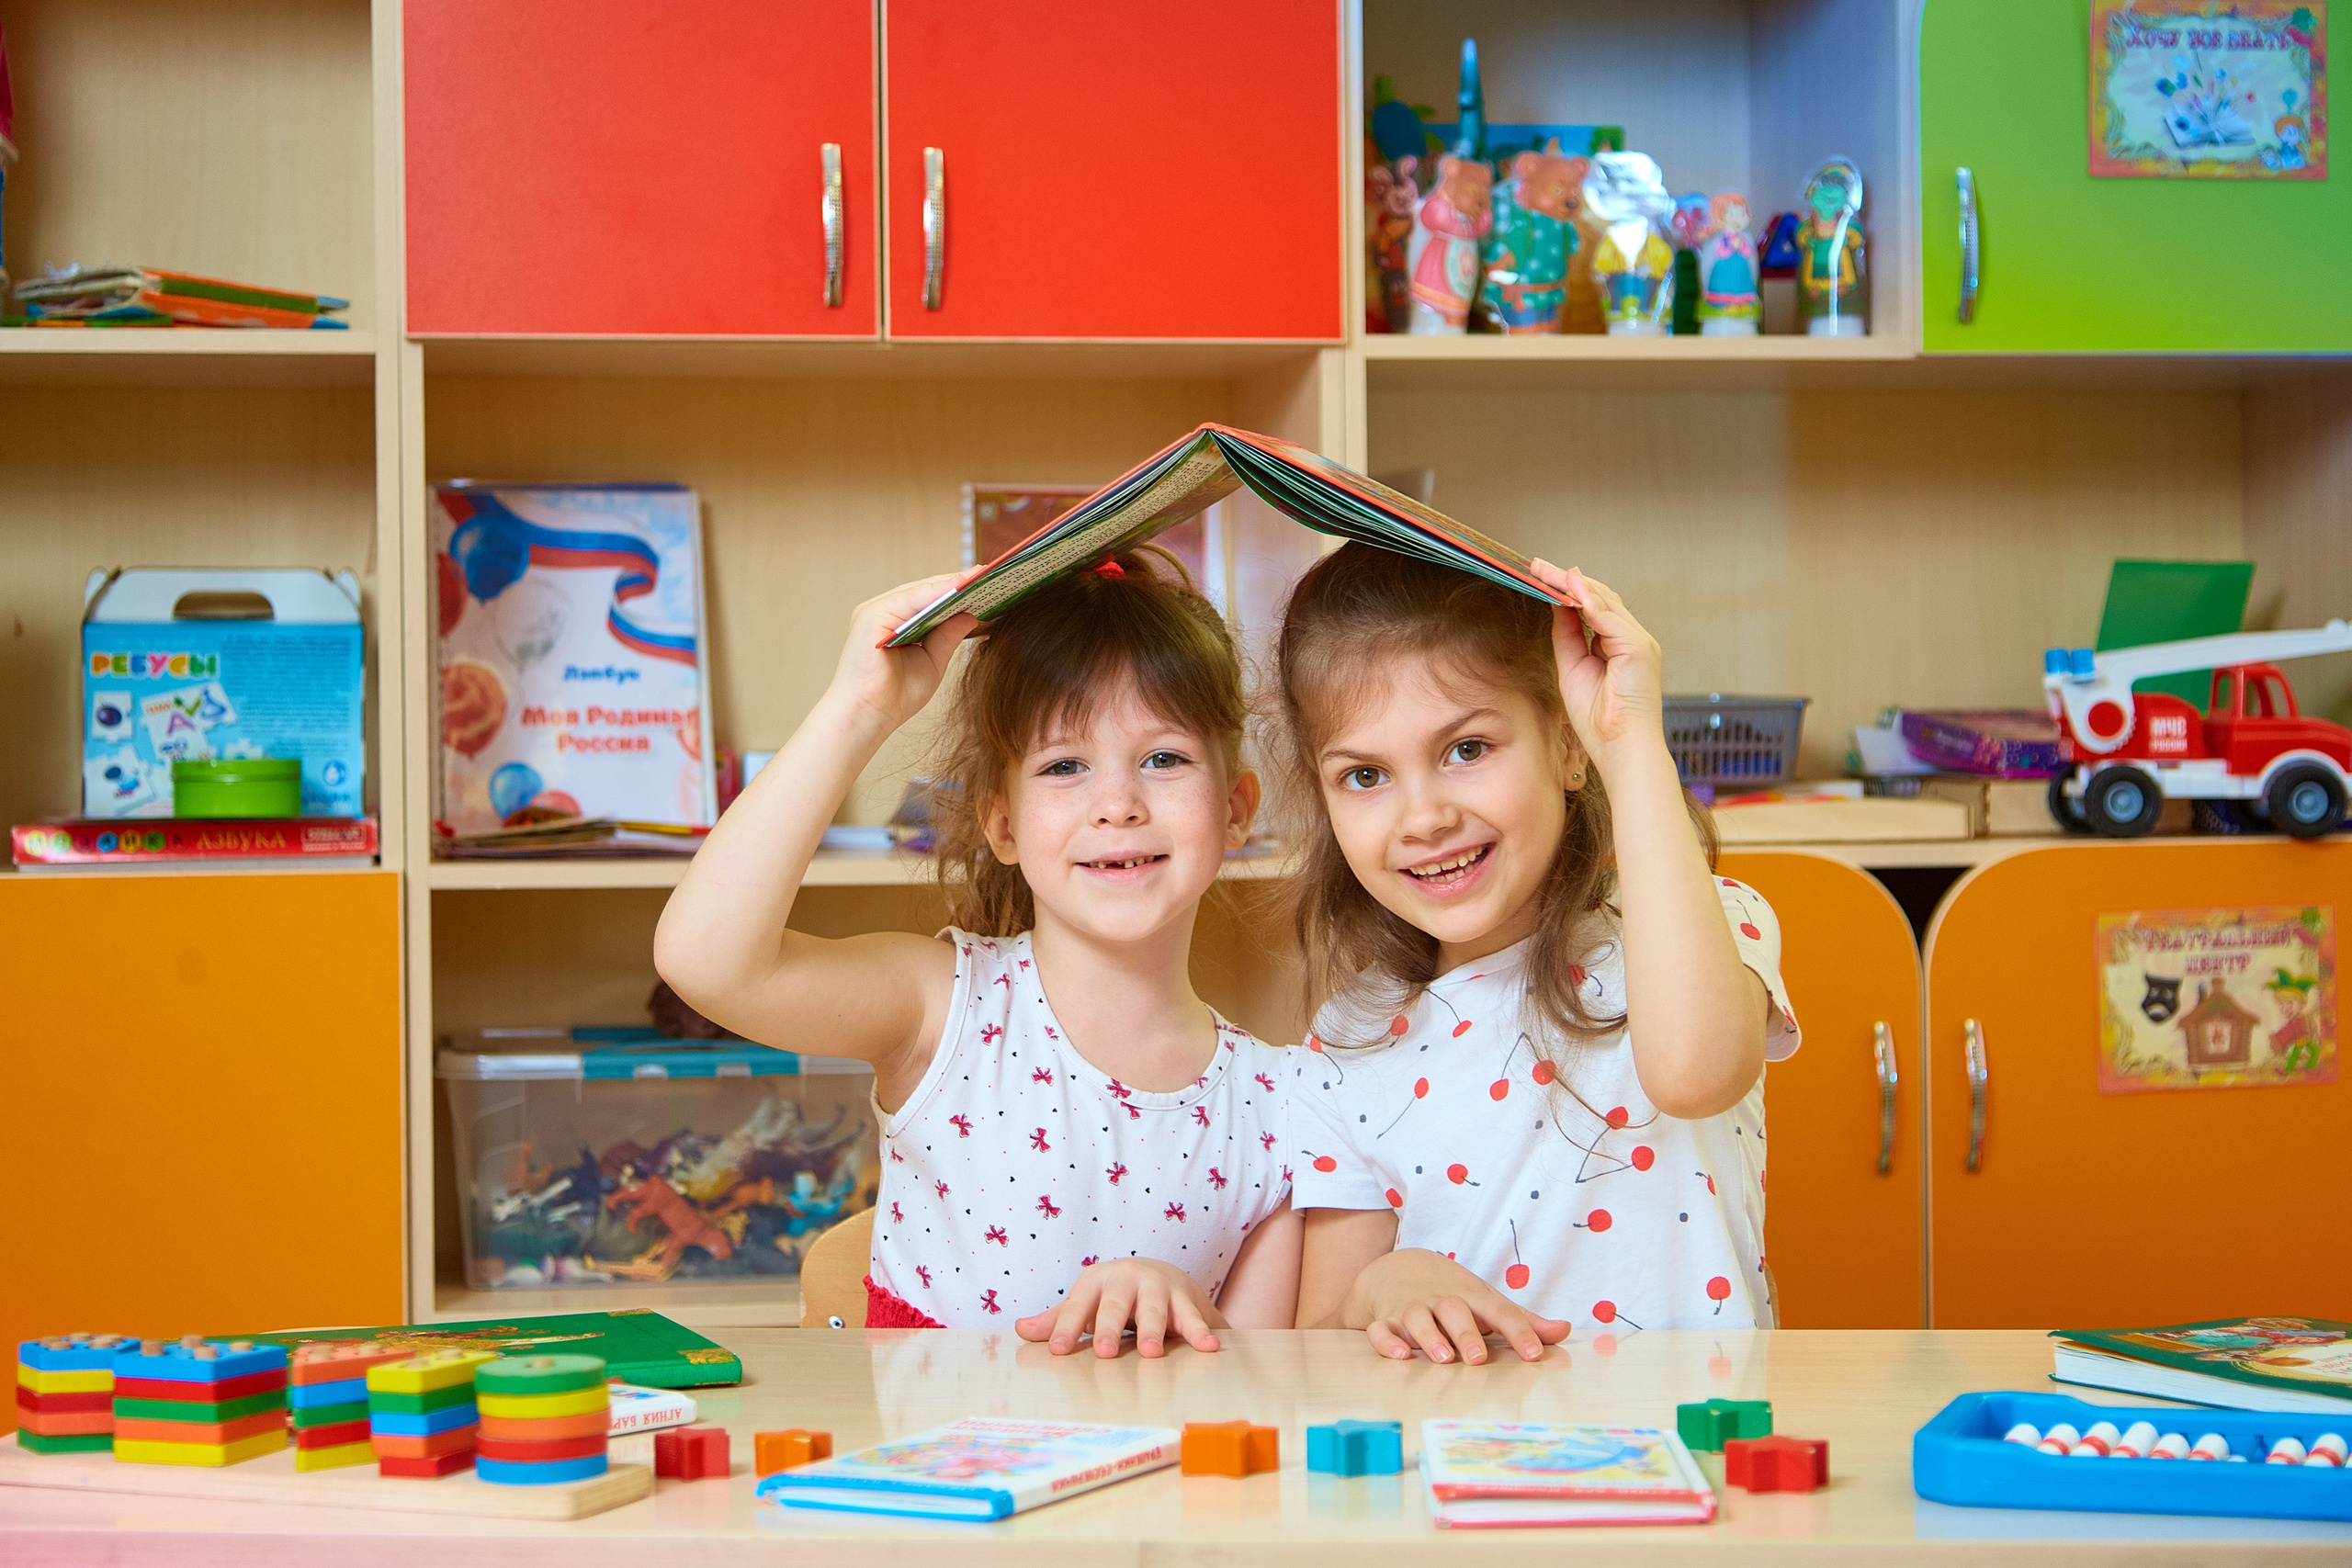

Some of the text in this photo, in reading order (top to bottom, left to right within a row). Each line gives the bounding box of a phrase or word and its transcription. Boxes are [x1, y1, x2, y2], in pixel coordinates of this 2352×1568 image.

[90, 652, 219, 677] РЕБУСЫ
[521, 705, 580, 727] Моя
[557, 732, 650, 752] Россия
[196, 830, 287, 852] АЗБУКА
[643, 1408, 682, 1426] АГНИЯ
